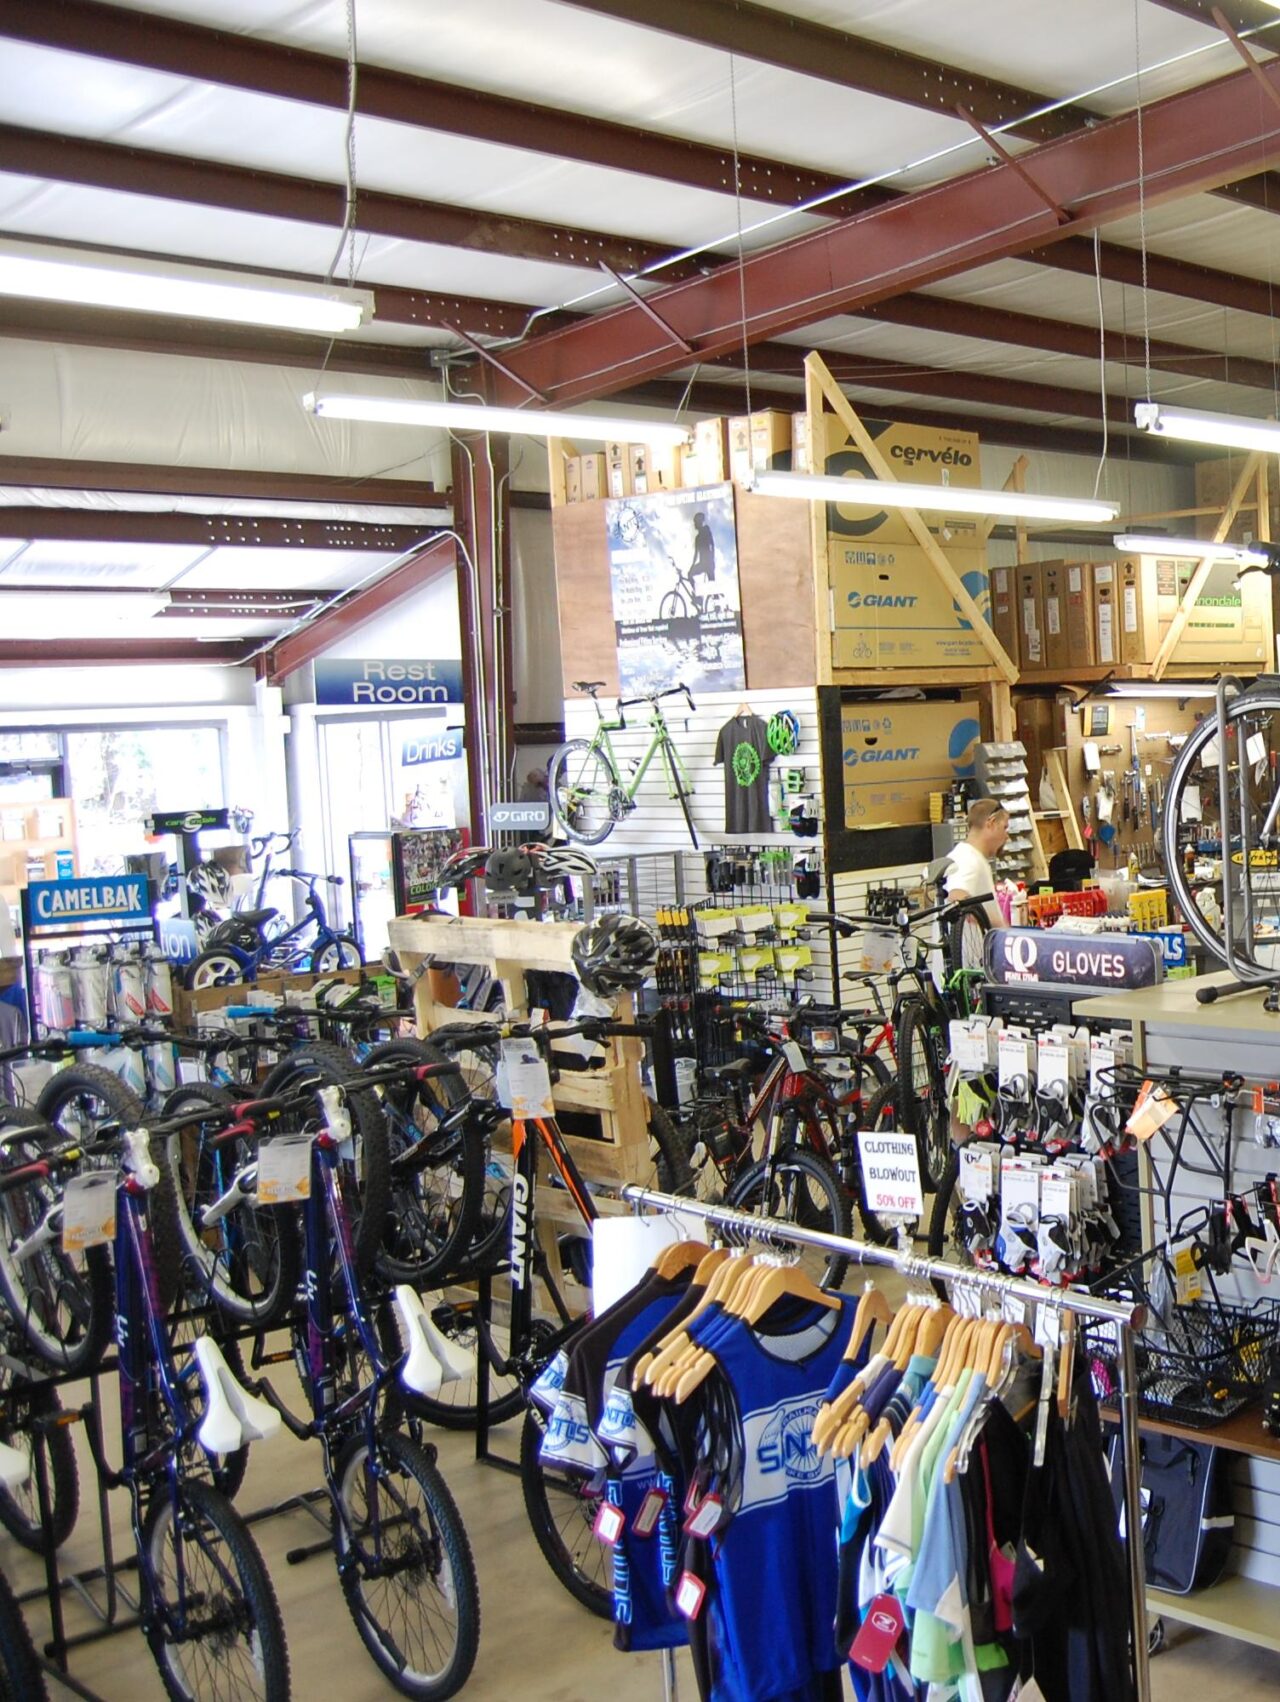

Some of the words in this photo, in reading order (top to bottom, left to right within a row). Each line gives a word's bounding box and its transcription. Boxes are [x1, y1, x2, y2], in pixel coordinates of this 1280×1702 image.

[862, 594, 918, 609] GIANT
[363, 660, 436, 681] Rest
[353, 682, 449, 703] Room
[406, 736, 457, 763] Drinks
[861, 748, 920, 763] GIANT
[510, 810, 545, 823] GIRO
[37, 883, 142, 919] CAMELBAK
[1052, 950, 1126, 978] GLOVES
[864, 1141, 914, 1156] CLOTHING
[869, 1166, 916, 1183] BLOWOUT
[876, 1193, 896, 1208] 50%
[897, 1195, 916, 1209] OFF
[511, 1172, 530, 1291] GIANT
